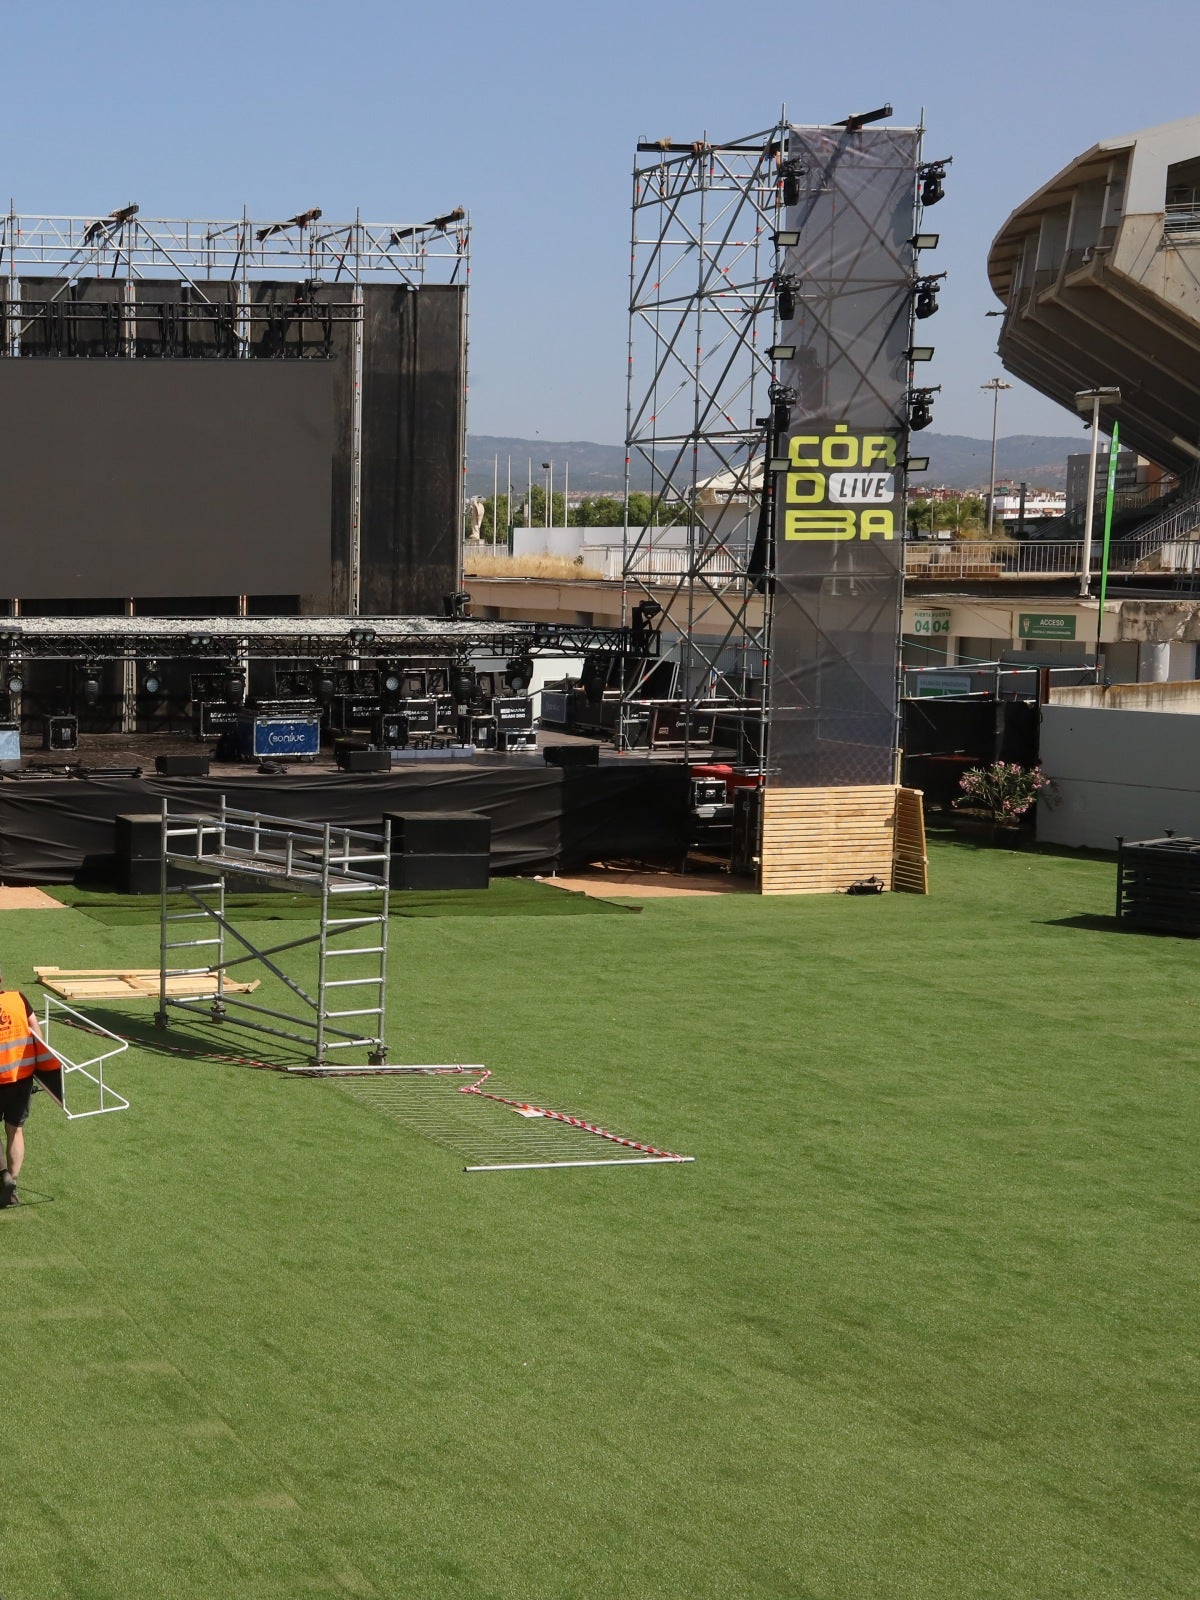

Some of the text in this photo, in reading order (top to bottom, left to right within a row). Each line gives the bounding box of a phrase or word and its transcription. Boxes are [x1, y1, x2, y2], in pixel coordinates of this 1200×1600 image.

[839, 478, 886, 498] LIVE
[785, 509, 894, 541] BA
[915, 620, 930, 632] 04
[932, 619, 950, 632] 04
